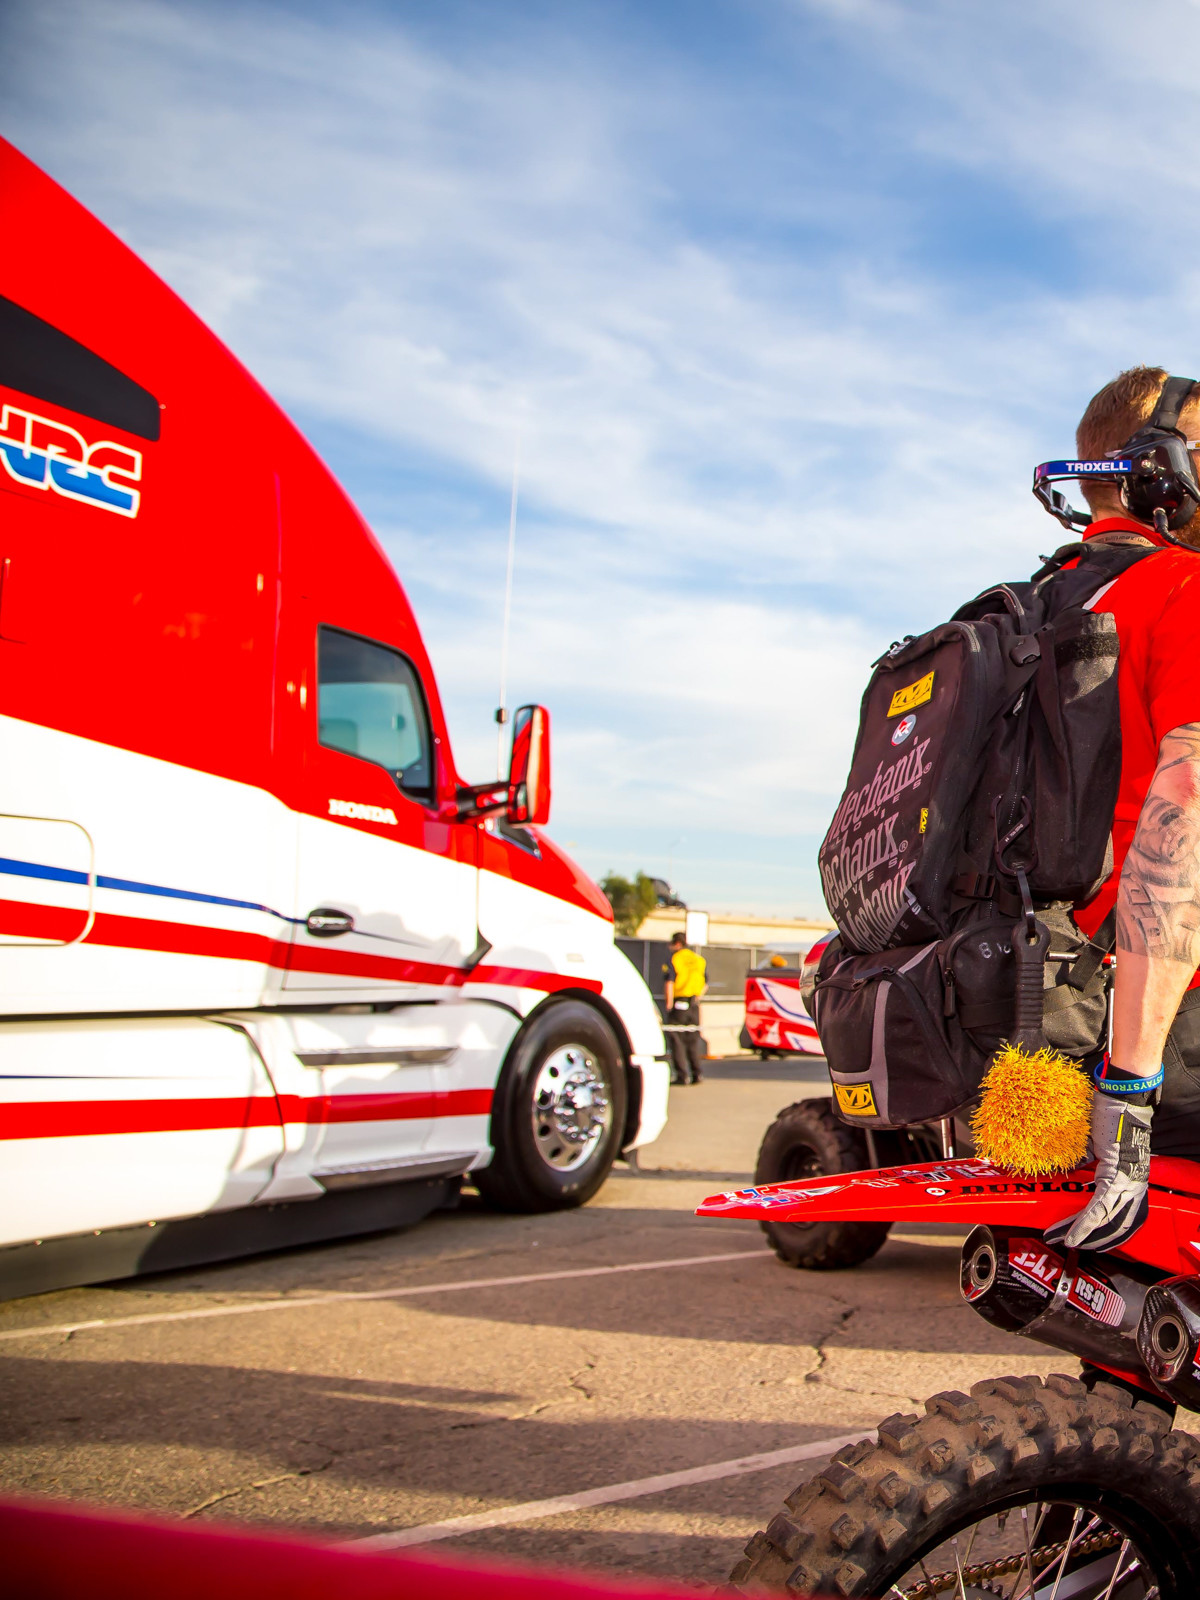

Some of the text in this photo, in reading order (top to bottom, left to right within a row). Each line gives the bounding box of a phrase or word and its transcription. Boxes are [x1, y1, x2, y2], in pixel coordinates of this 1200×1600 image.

[1065, 462, 1128, 472] TROXELL
[824, 736, 931, 847] Mechanix
[328, 799, 398, 825] HONDA
